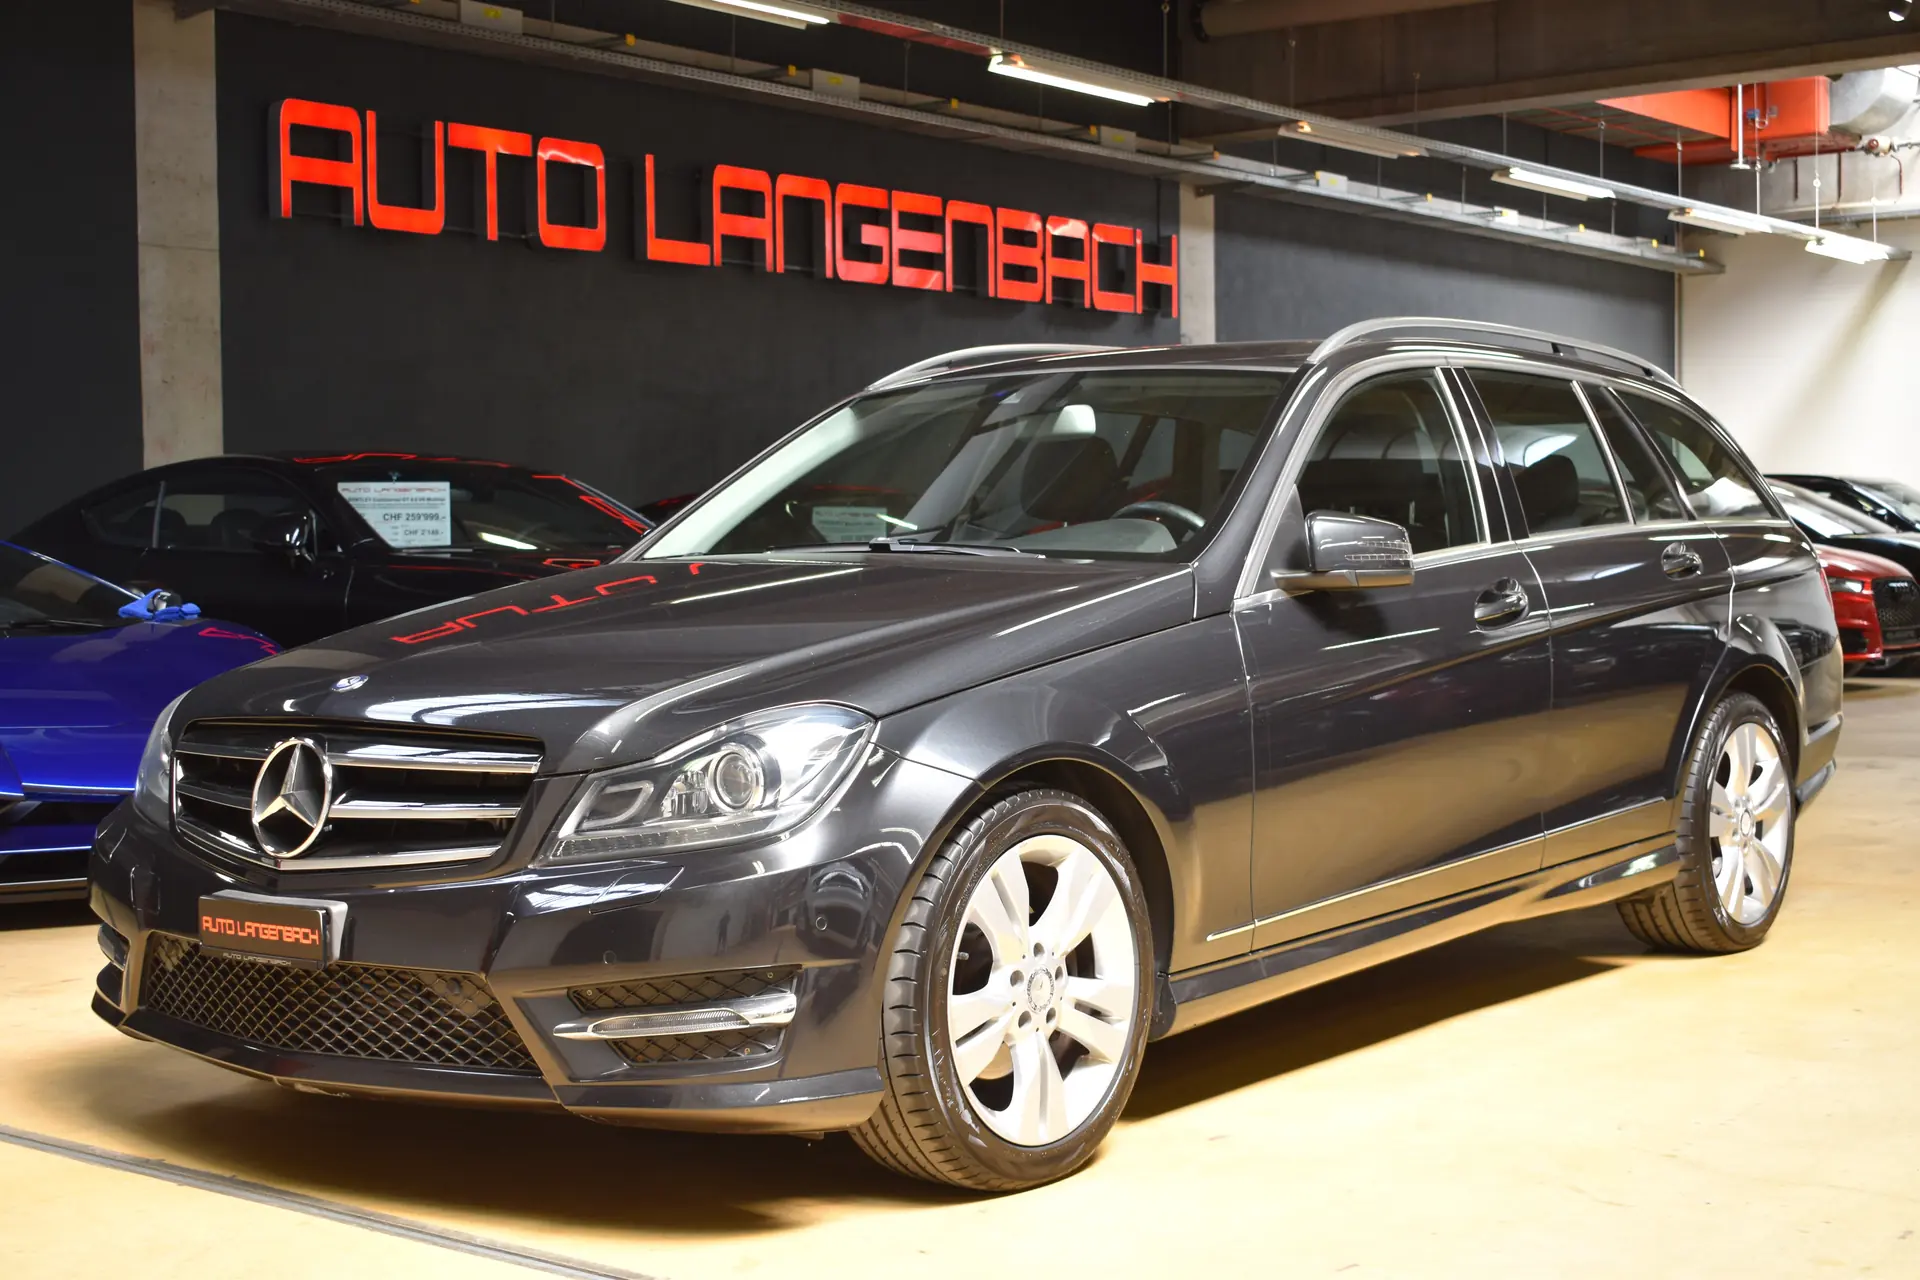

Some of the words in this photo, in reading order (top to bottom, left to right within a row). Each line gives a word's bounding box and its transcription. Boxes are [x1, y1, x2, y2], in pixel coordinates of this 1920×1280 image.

[279, 98, 607, 252] AUTO
[645, 153, 1178, 318] LANGENBACH
[383, 512, 403, 521] CHF
[202, 916, 235, 935] AUTO
[237, 921, 320, 945] LANGENBACH
[222, 952, 242, 960] AUTO
[243, 955, 292, 966] LANGENBACH
